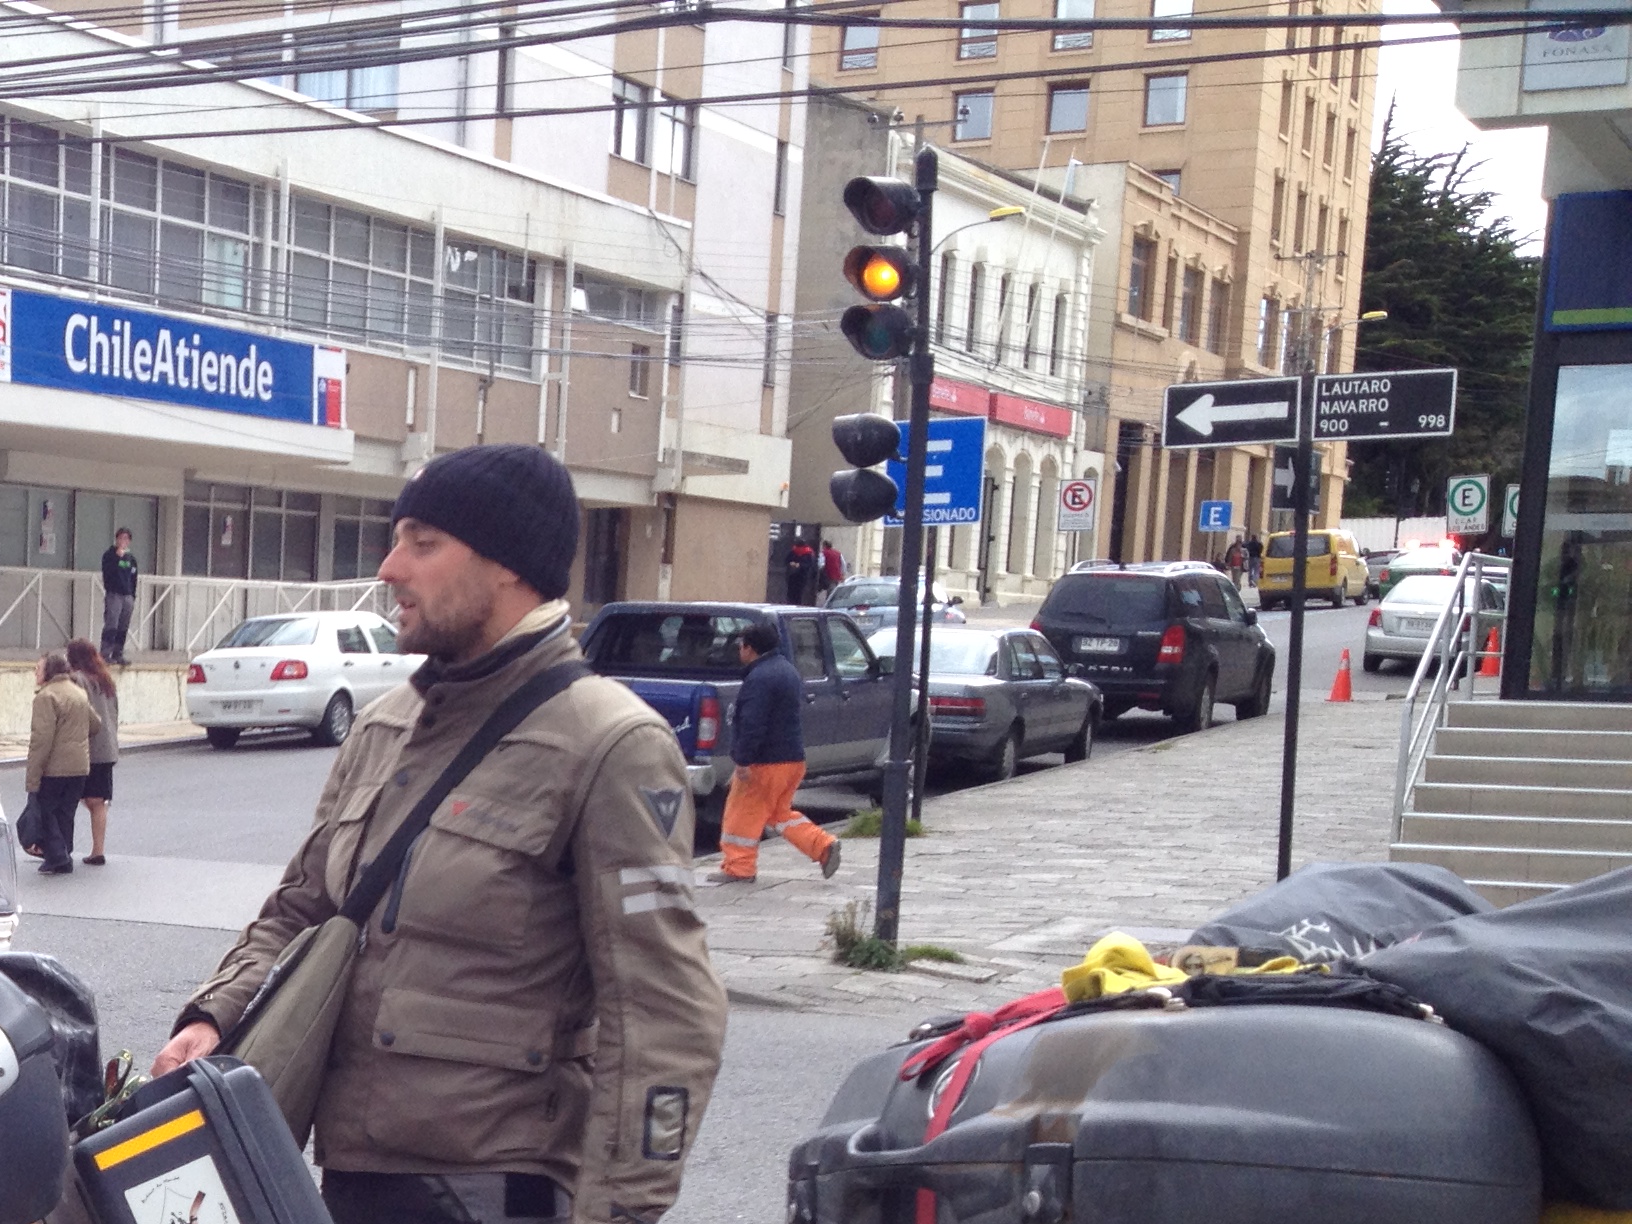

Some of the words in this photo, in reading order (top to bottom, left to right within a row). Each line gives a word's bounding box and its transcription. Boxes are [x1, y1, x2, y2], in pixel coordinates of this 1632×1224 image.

[1542, 44, 1612, 58] FONASA
[64, 313, 274, 401] ChileAtiende
[1321, 379, 1391, 396] LAUTARO
[1320, 398, 1389, 415] NAVARRO
[1319, 419, 1349, 433] 900
[1418, 414, 1446, 429] 998
[1461, 487, 1474, 508] E
[1209, 506, 1223, 525] E
